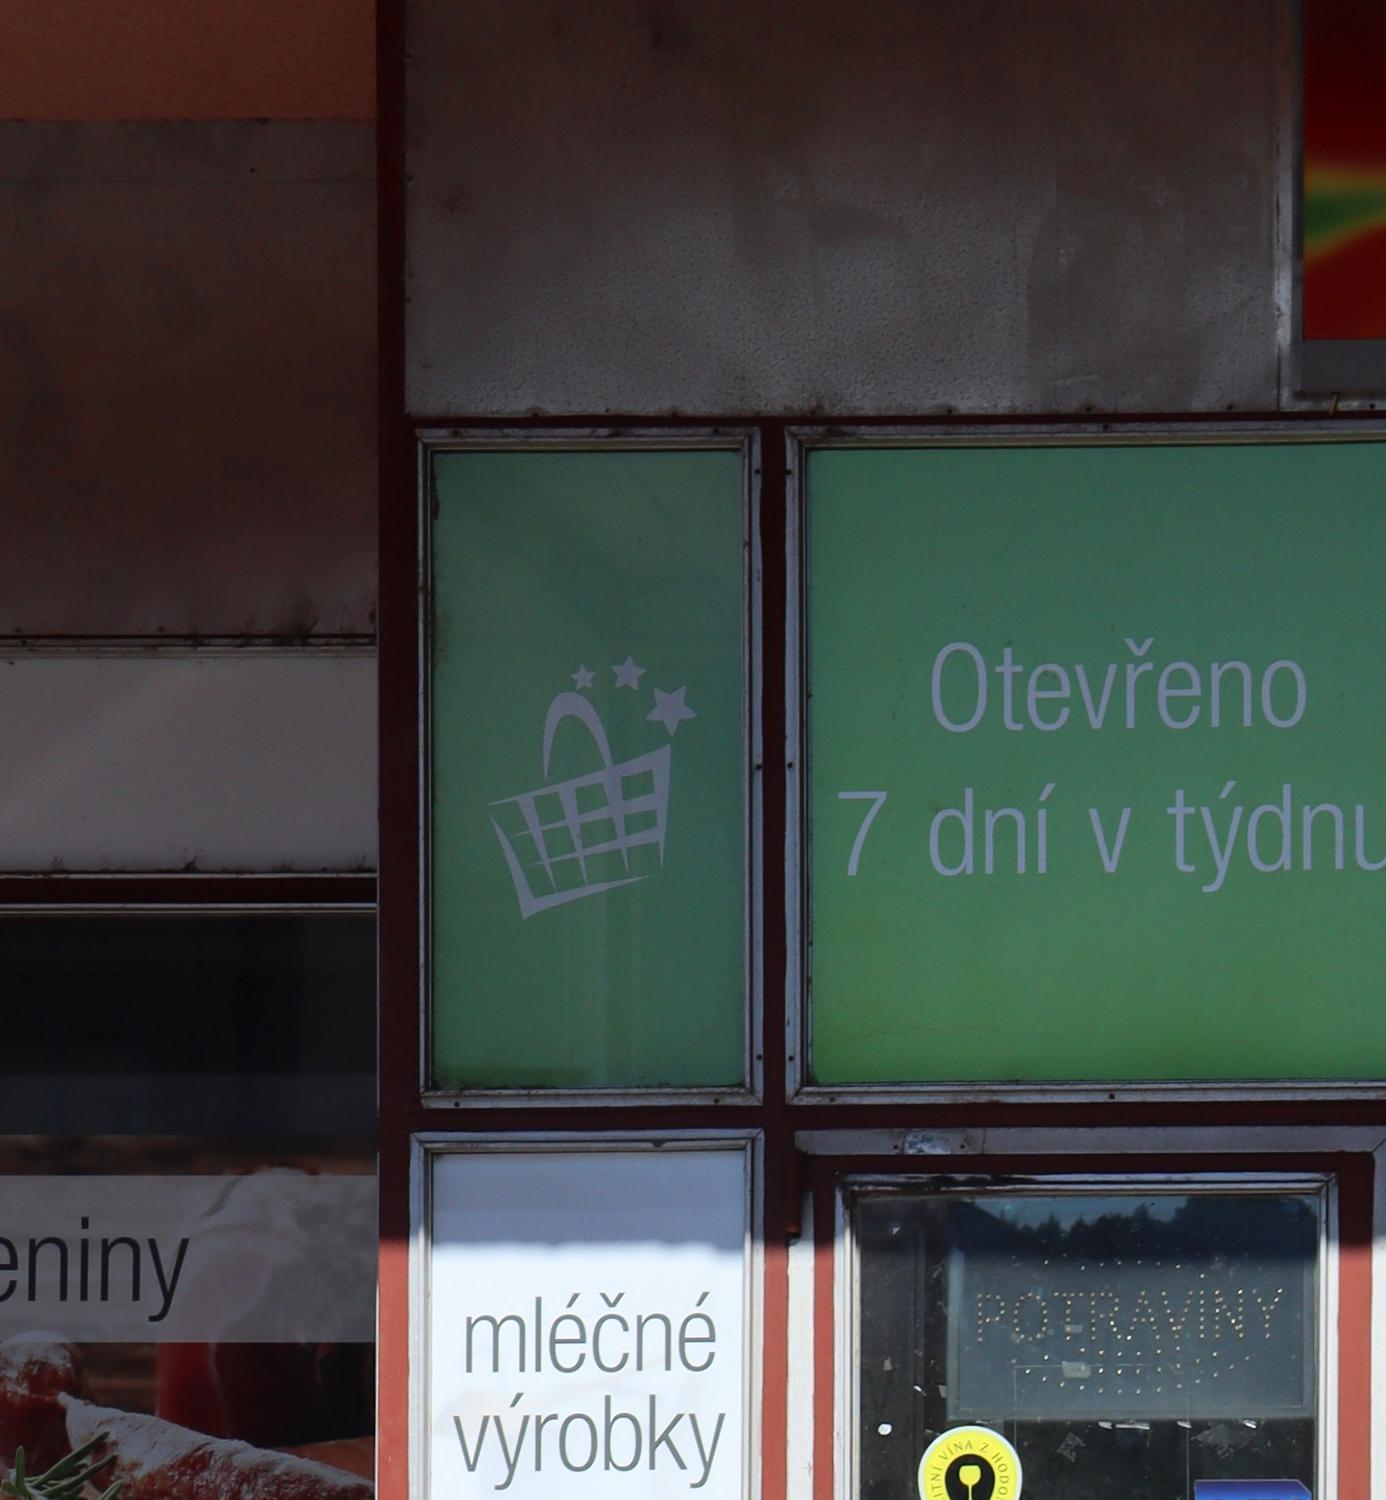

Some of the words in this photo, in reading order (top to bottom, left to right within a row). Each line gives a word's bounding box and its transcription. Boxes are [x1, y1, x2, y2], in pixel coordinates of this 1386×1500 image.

[930, 637, 1307, 733] Otevřeno
[837, 790, 888, 877] 7
[928, 782, 1056, 876] dní
[1088, 807, 1132, 874] v
[465, 1291, 717, 1375] mléčné
[977, 1287, 1284, 1343] POTRAVINY
[453, 1392, 727, 1491] výrobky
